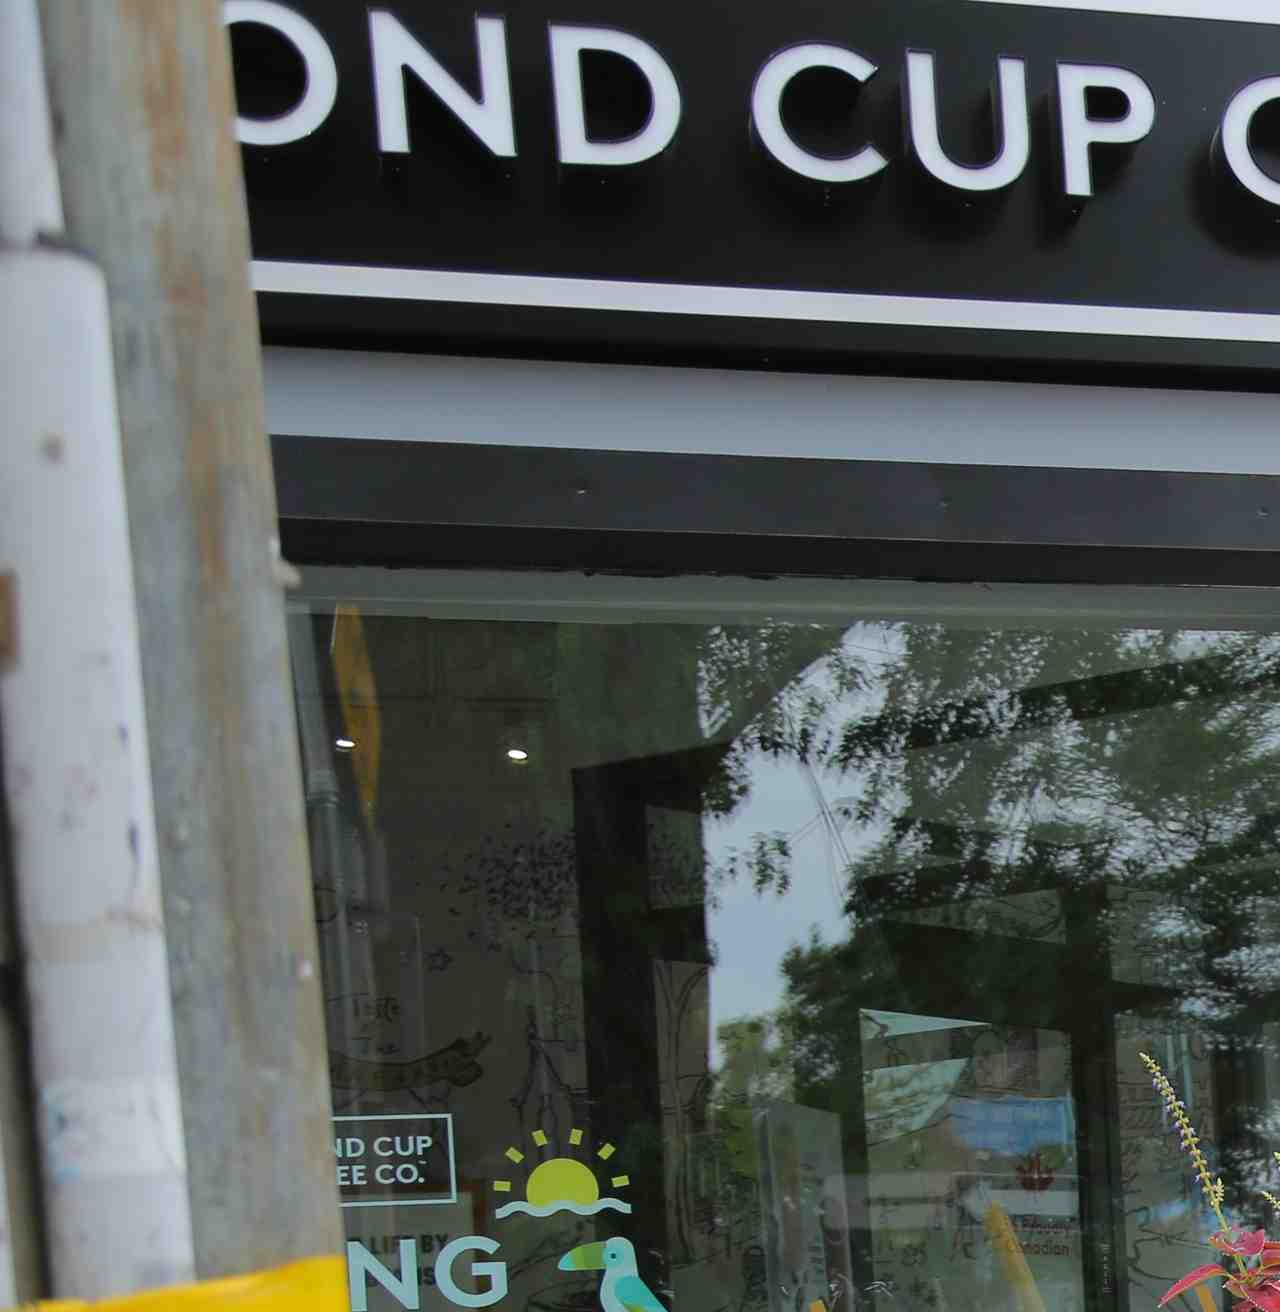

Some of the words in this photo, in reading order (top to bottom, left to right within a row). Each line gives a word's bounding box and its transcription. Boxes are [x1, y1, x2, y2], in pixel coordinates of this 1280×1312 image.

[223, 0, 683, 166] OND
[751, 41, 1157, 195] CUP
[373, 1135, 433, 1157] CUP
[374, 1163, 425, 1184] CO.
[348, 1235, 509, 1312] NG
